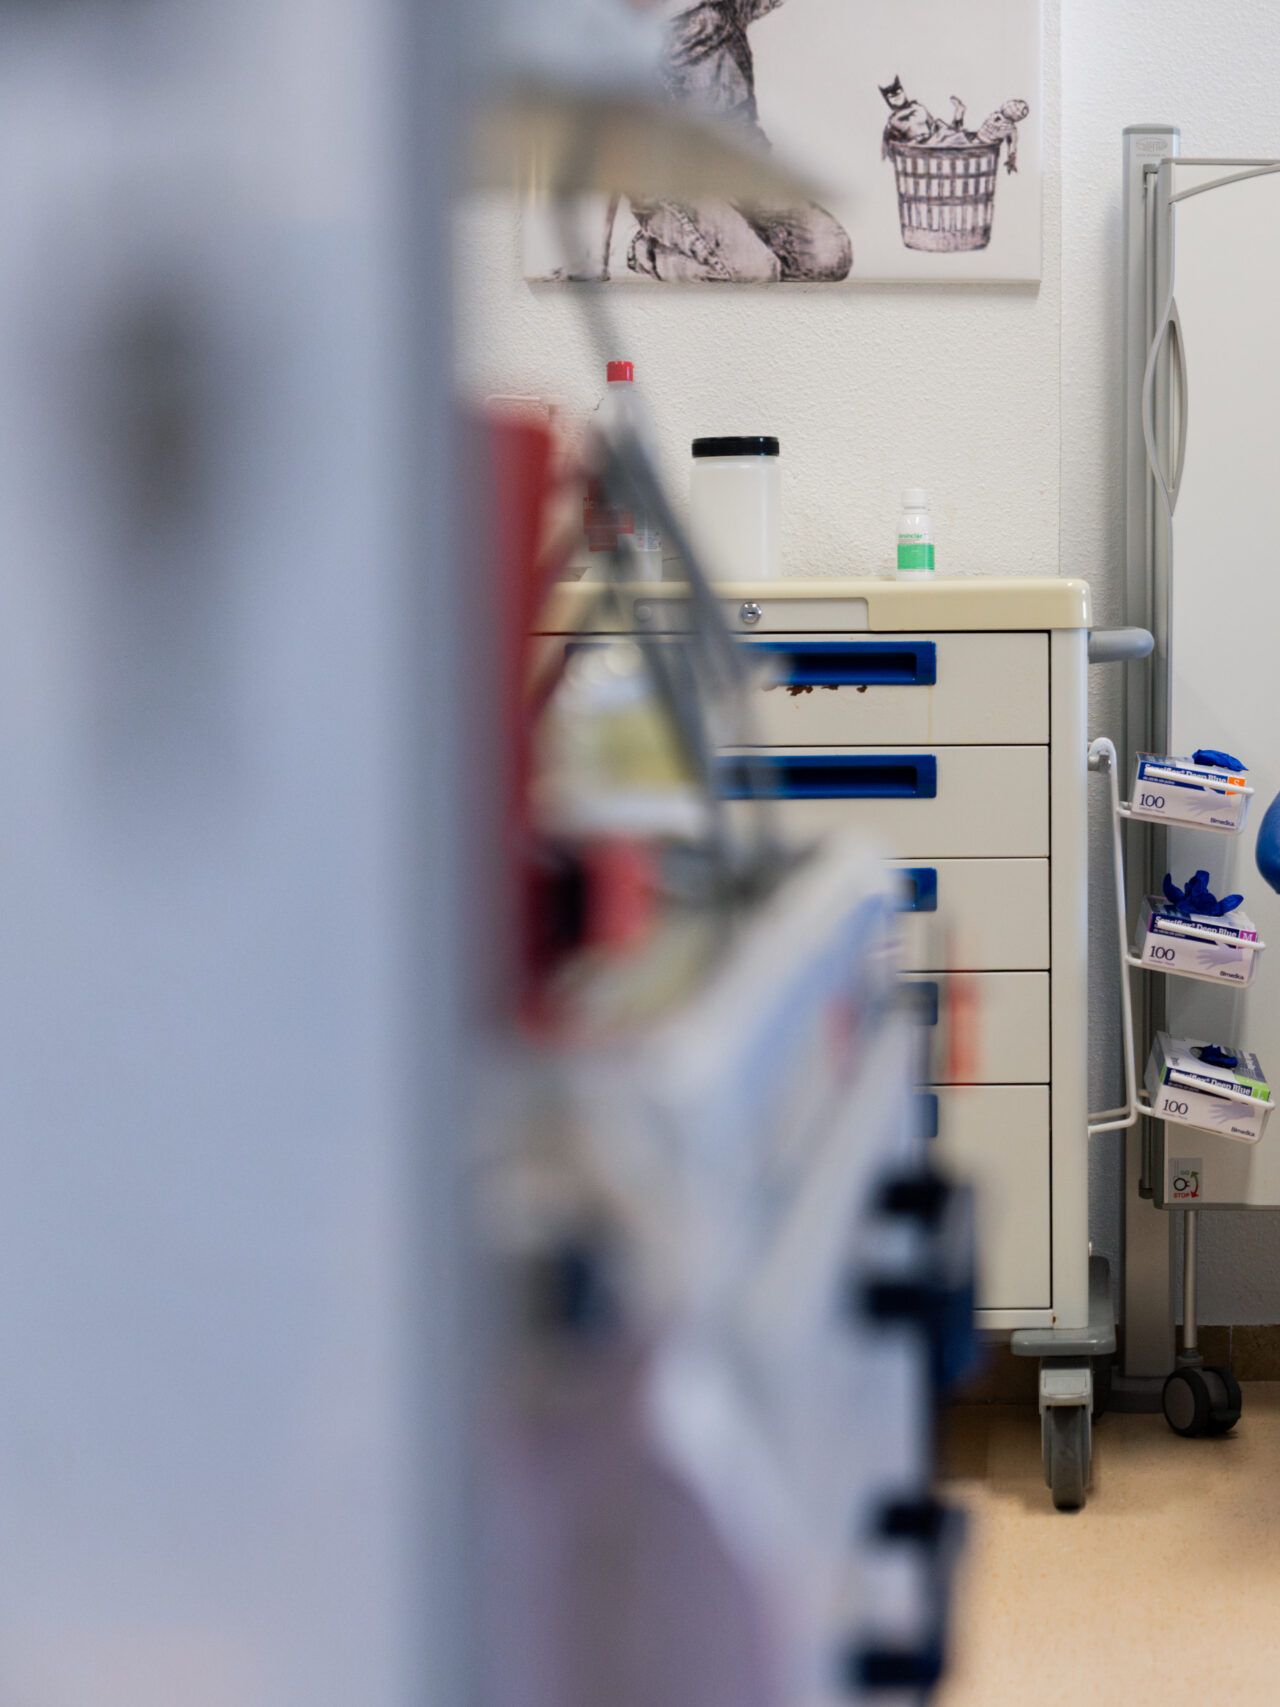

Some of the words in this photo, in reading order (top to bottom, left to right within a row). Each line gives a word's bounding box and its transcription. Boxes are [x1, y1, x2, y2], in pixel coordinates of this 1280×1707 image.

[1139, 794, 1165, 808] 100
[1149, 945, 1175, 960] 100
[1163, 1099, 1188, 1114] 100
